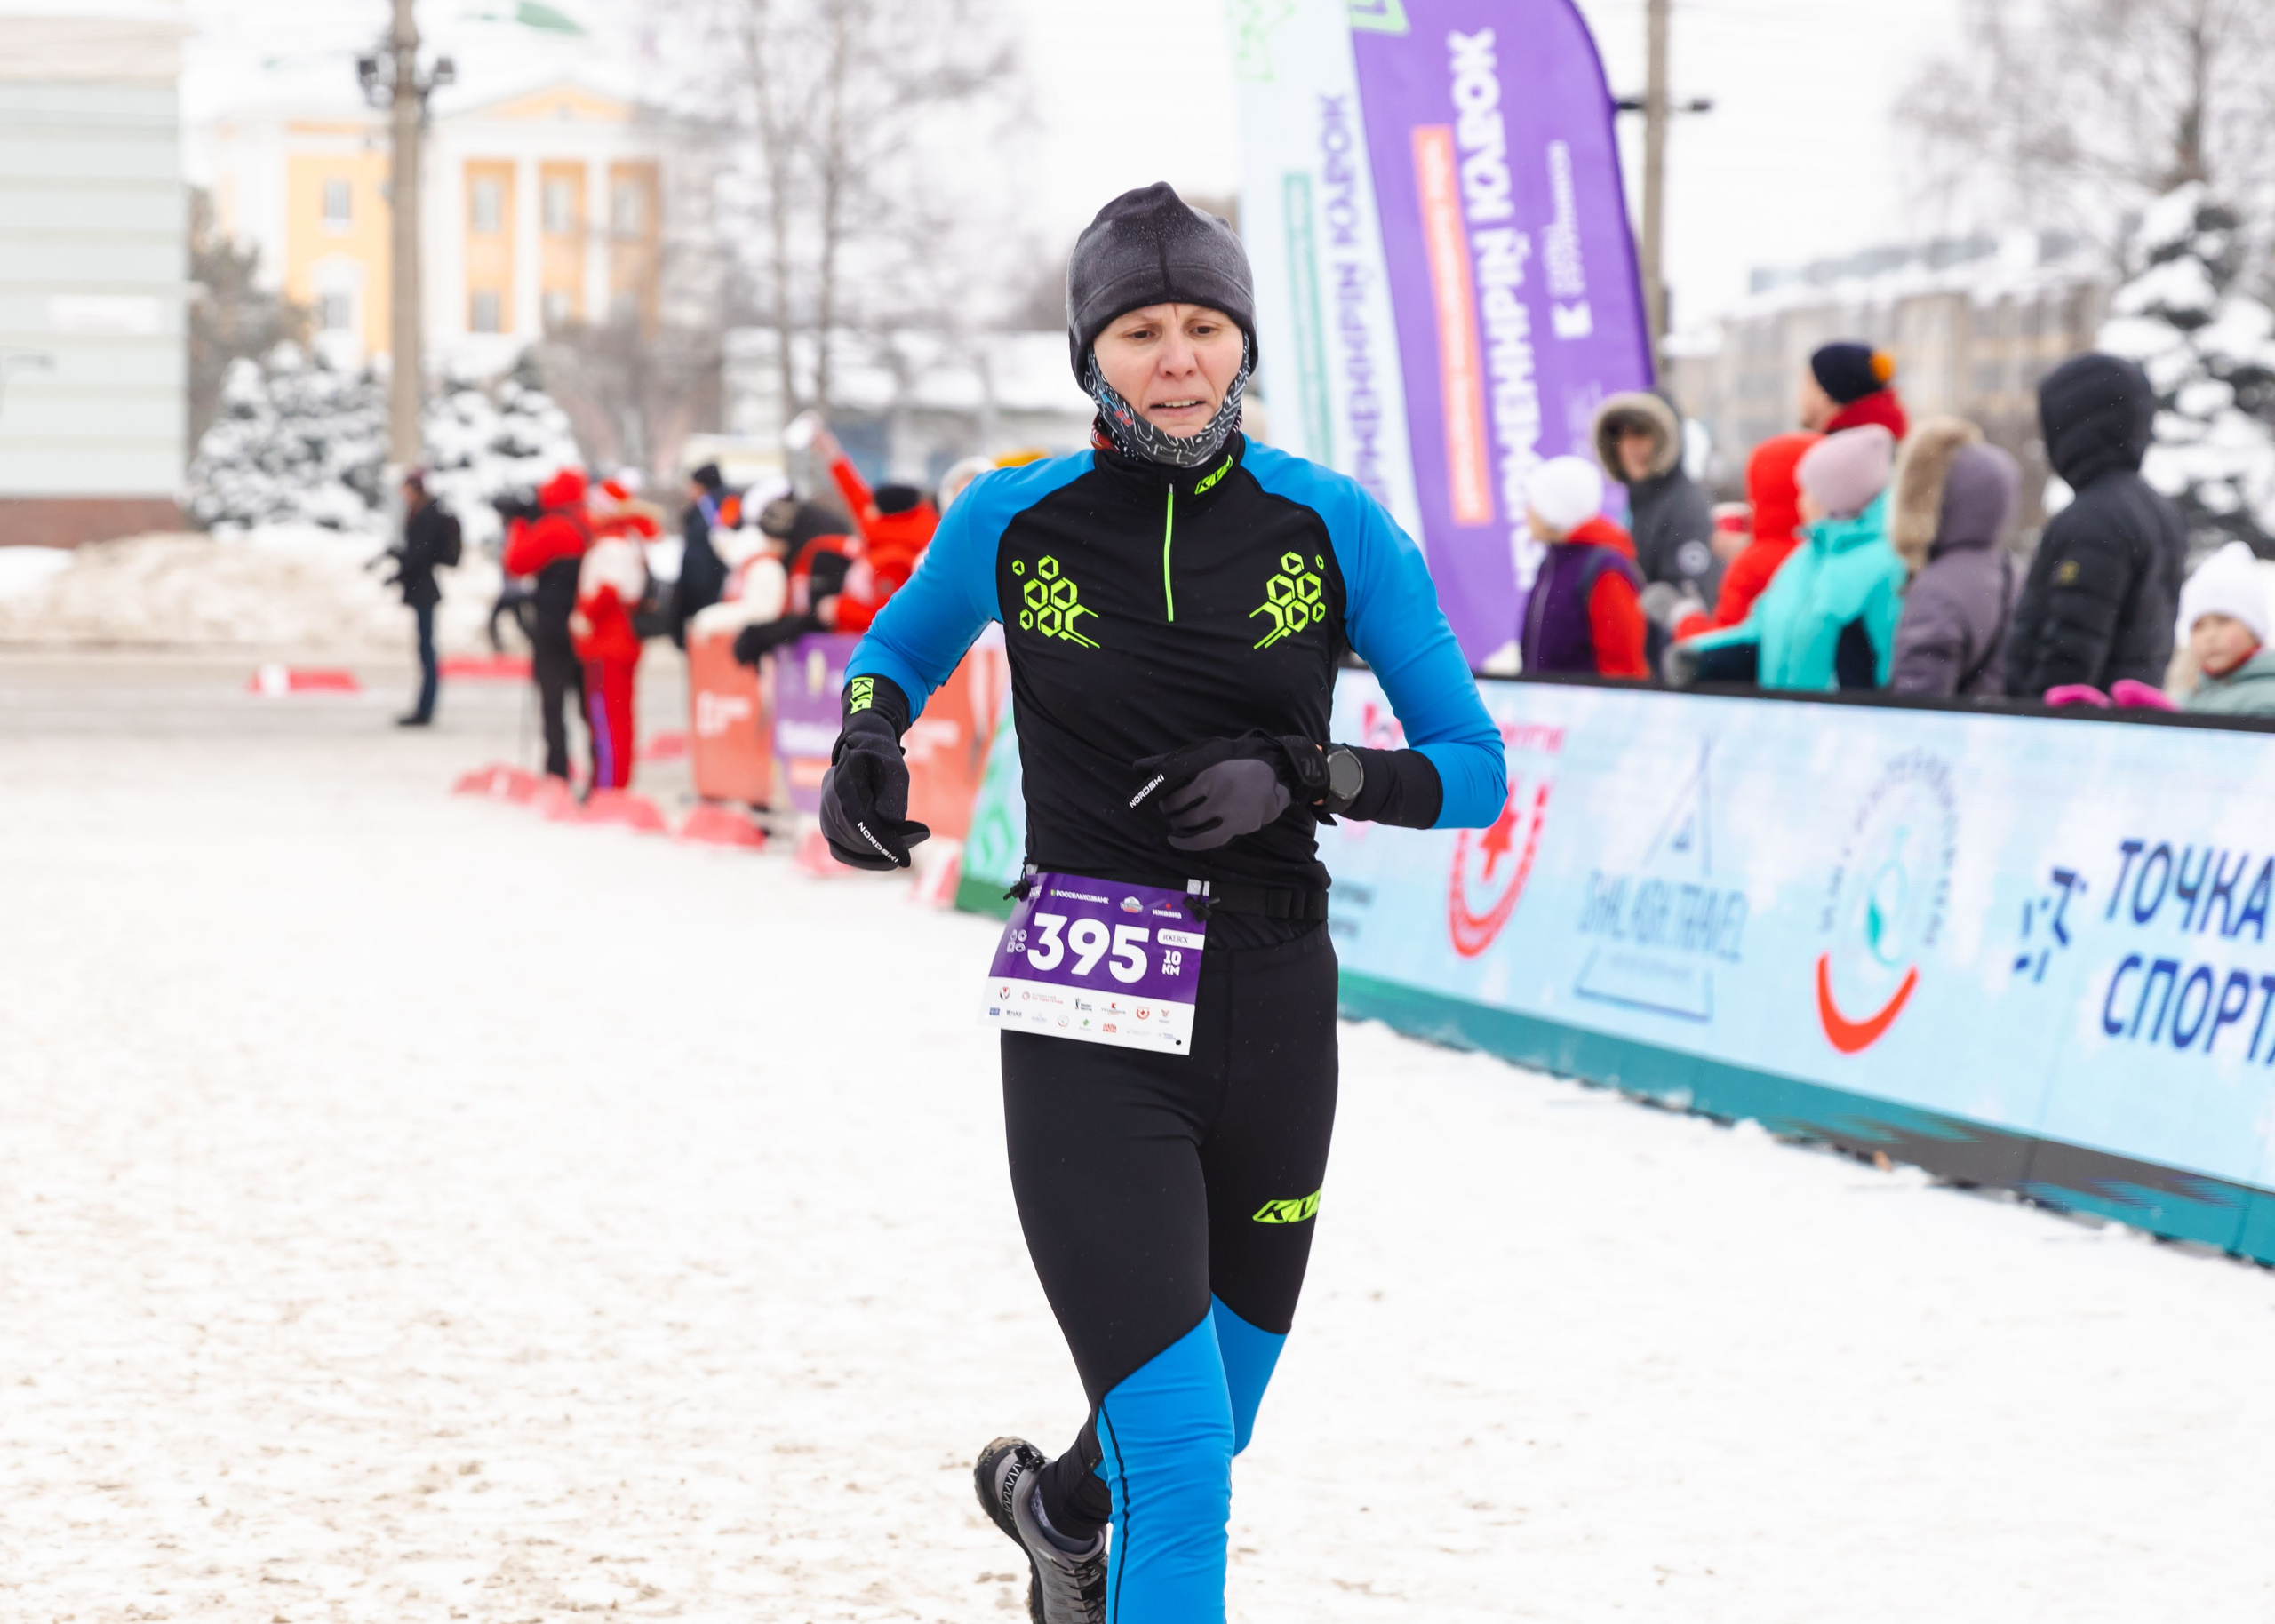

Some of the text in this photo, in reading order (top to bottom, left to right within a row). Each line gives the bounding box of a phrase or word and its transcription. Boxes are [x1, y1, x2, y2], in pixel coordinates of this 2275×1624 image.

[1130, 773, 1164, 808] NORDSKI
[858, 822, 898, 863] NORDSKI
[2106, 840, 2273, 940] ТОЧКА
[1027, 912, 1149, 983] 395
[1163, 949, 1182, 966] 10
[1161, 963, 1181, 976] КМ
[2104, 954, 2275, 1066] СПОРТ
